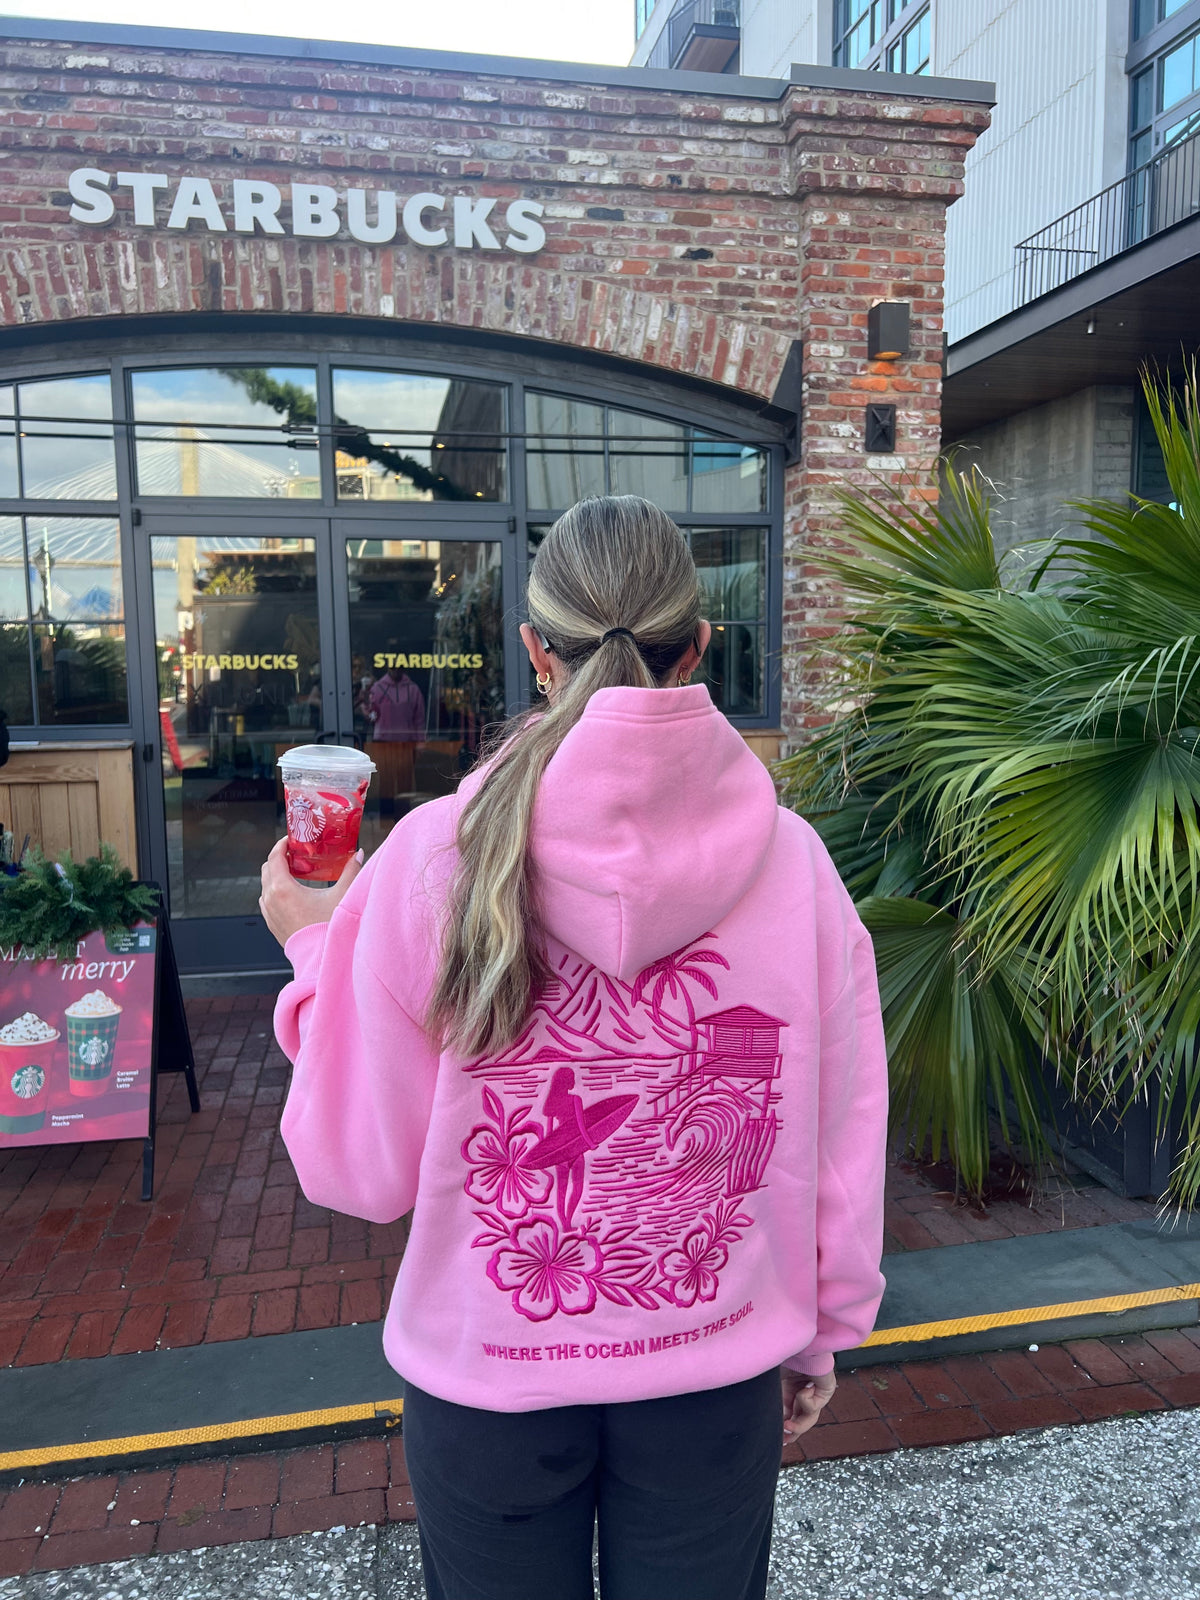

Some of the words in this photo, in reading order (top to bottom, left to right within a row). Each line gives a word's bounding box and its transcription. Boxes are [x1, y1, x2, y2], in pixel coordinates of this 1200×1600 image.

[68, 167, 547, 253] STARBUCKS
[181, 654, 299, 670] STARBUCKS
[373, 652, 484, 669] STARBUCKS
[61, 959, 136, 983] merry
[52, 1113, 84, 1121] Peppermint
[482, 1343, 542, 1361] WHERE
[544, 1343, 581, 1361] THE
[584, 1339, 646, 1359] OCEAN
[648, 1328, 700, 1353] MEETS
[702, 1317, 728, 1338] THE
[728, 1300, 754, 1327] SOUL
